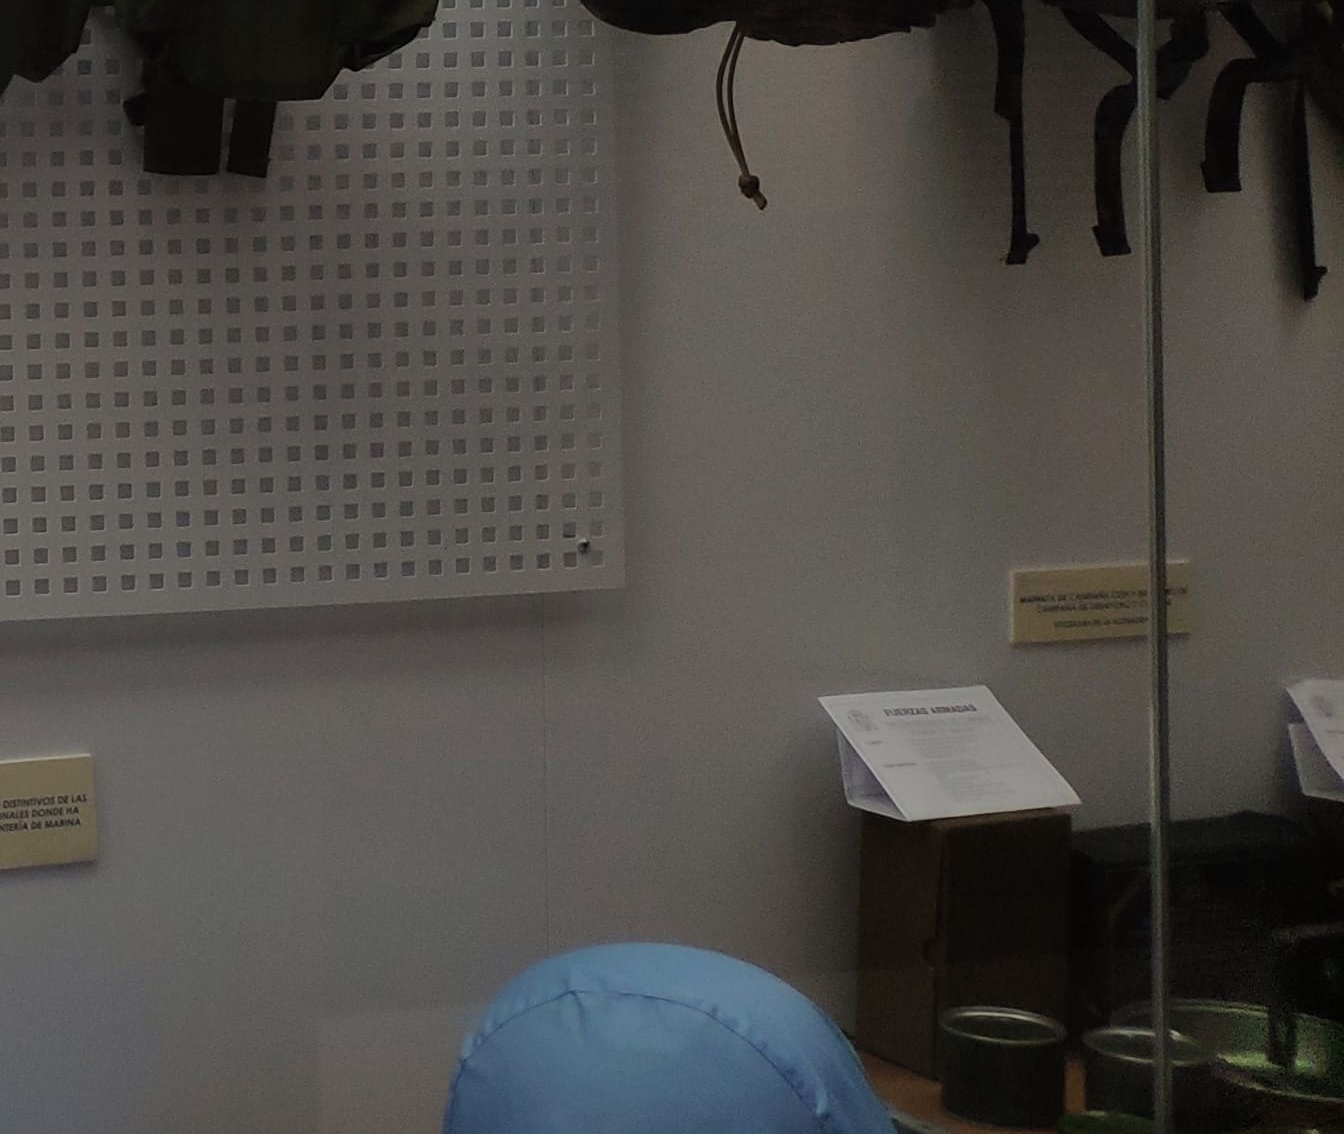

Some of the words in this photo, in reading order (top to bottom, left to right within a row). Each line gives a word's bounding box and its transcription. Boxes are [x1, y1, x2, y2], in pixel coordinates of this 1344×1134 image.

[3, 797, 55, 809] DISTINTIVOS
[57, 795, 69, 804] DE
[71, 794, 87, 803] LAS
[31, 807, 63, 818] DONDE
[66, 806, 80, 815] HA
[31, 820, 43, 830] DE
[45, 817, 81, 829] MARINA
